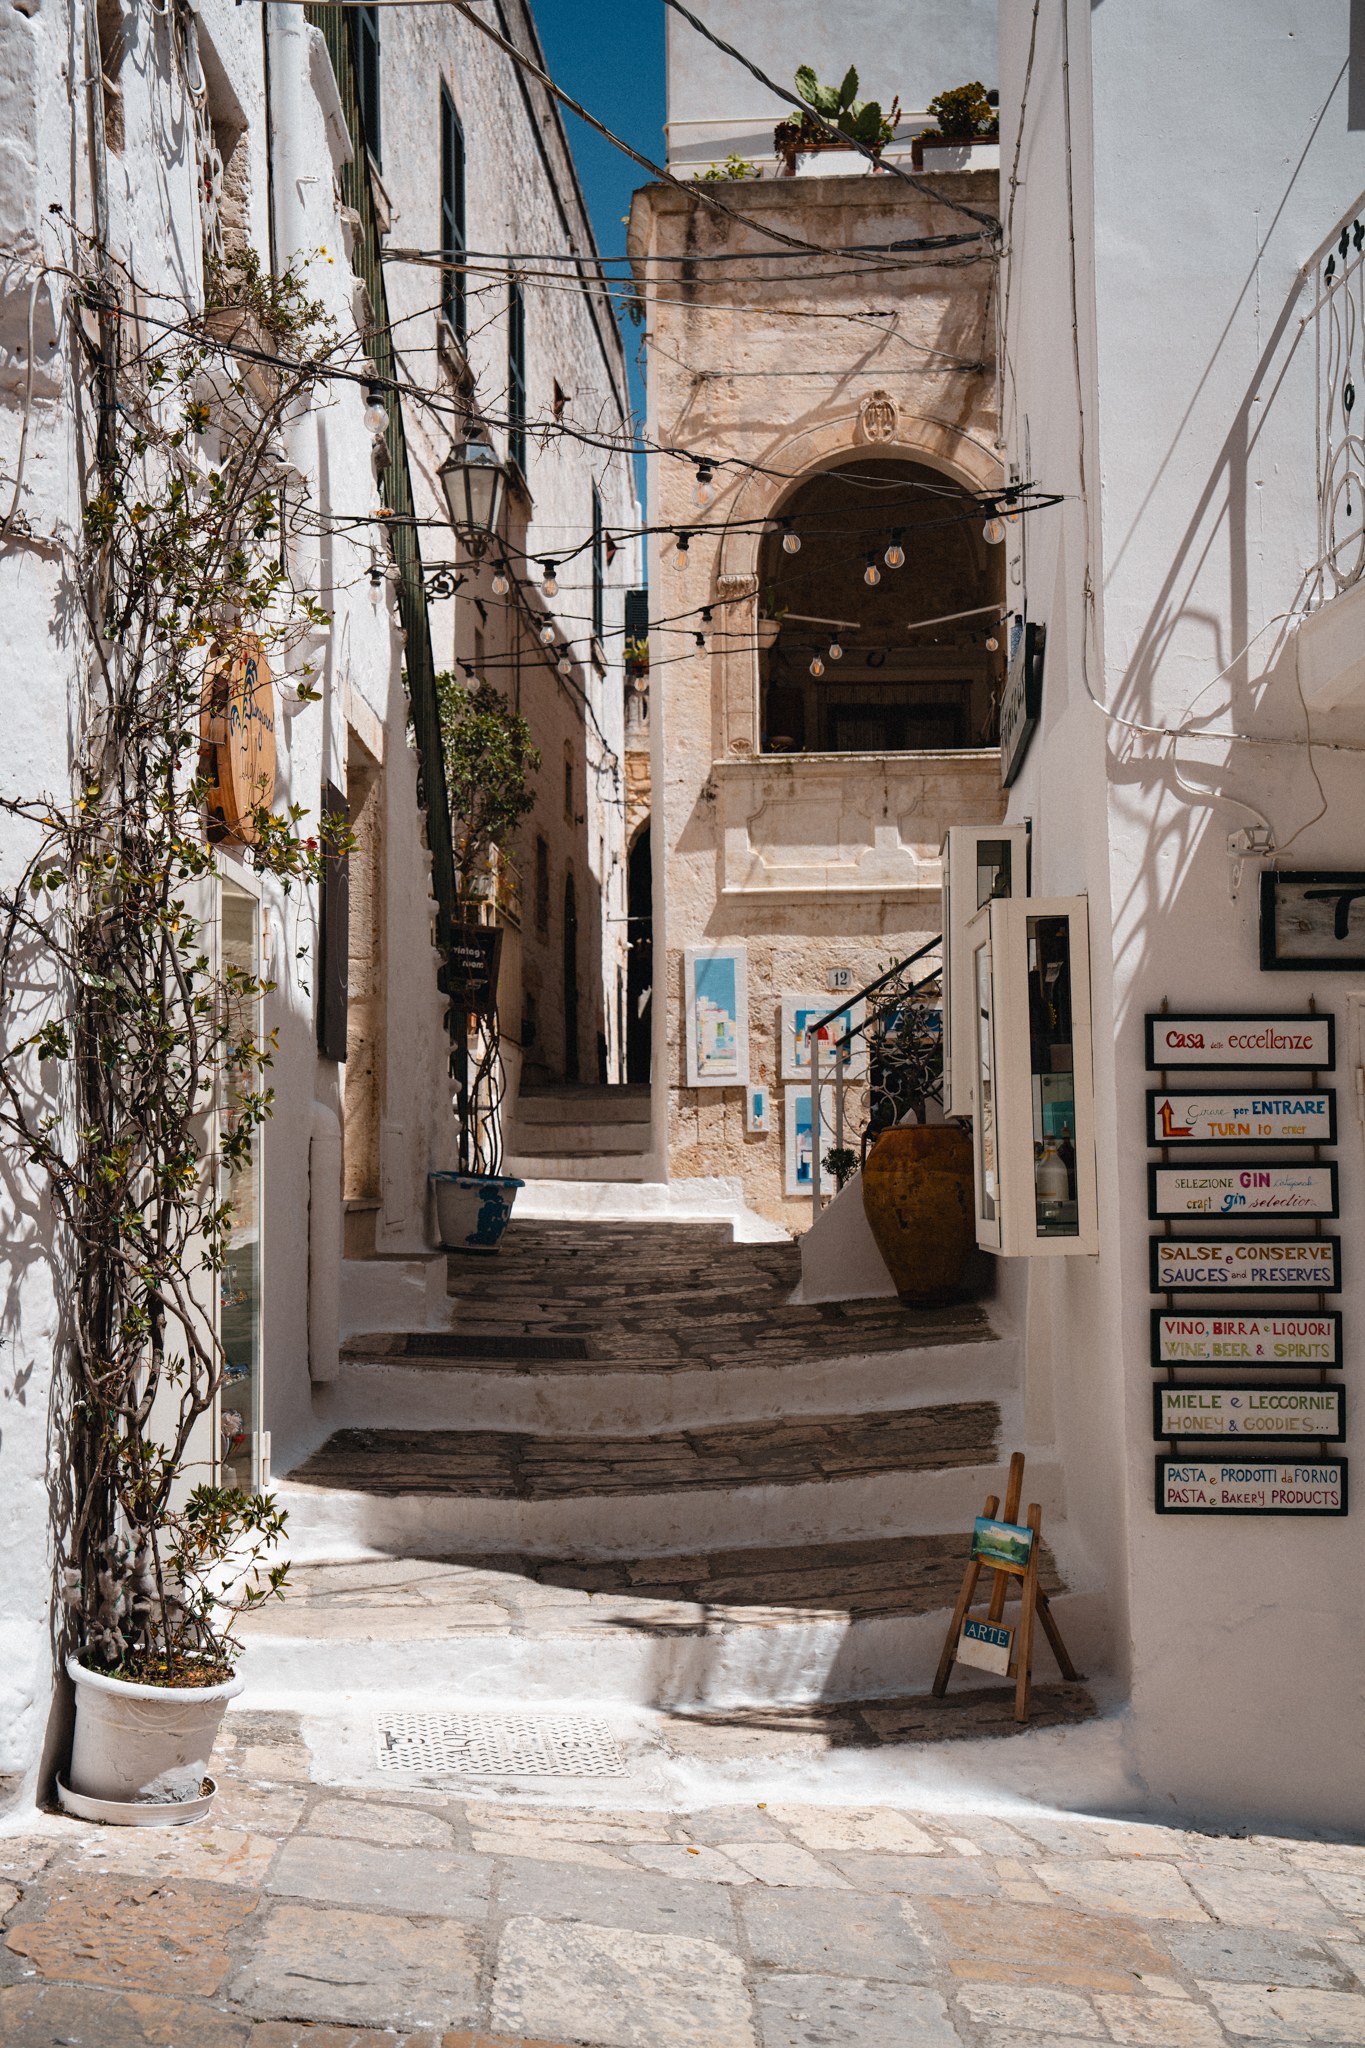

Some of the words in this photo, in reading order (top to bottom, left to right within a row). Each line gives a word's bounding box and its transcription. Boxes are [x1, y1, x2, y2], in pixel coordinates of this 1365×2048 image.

[834, 971, 848, 986] 12
[1165, 1030, 1205, 1049] Casa
[1228, 1028, 1314, 1050] eccellenze
[1232, 1107, 1250, 1119] per
[1252, 1100, 1325, 1115] ENTRARE
[1207, 1122, 1250, 1137] TURN
[1281, 1126, 1307, 1136] enter
[1174, 1178, 1234, 1189] SELEZIONE
[1239, 1171, 1271, 1189] GIN
[1186, 1197, 1212, 1211] craft
[1220, 1193, 1247, 1213] gin
[1249, 1193, 1319, 1209] selection
[1160, 1247, 1222, 1261] SALSE
[1225, 1255, 1234, 1265] e
[1235, 1247, 1332, 1261] CONSERVE
[1161, 1268, 1231, 1284] SAUCES
[1231, 1270, 1247, 1279] and
[1251, 1268, 1331, 1282] PRESERVES
[1164, 1322, 1210, 1338] VINO,
[1212, 1322, 1260, 1336] BIRRA
[1273, 1322, 1331, 1337] LIQUORI
[1164, 1342, 1211, 1359] WINE,
[1212, 1342, 1252, 1357] BEER
[1256, 1344, 1265, 1356] &
[1273, 1343, 1330, 1358] SPIRITS
[1167, 1395, 1222, 1409] MIELE
[1230, 1397, 1243, 1408] e
[1249, 1396, 1335, 1410] LECCORNIE
[1166, 1416, 1224, 1433] HONEY
[1228, 1419, 1239, 1432] &
[1168, 1468, 1207, 1482] PASTA
[1209, 1477, 1217, 1485] e
[1221, 1469, 1277, 1483] PRODOTTI
[1281, 1469, 1293, 1484] da
[1294, 1469, 1338, 1484] FORNO
[1167, 1488, 1206, 1503] PASTA
[1271, 1490, 1339, 1506] PRODUCTS
[966, 1624, 1008, 1646] ARTE
